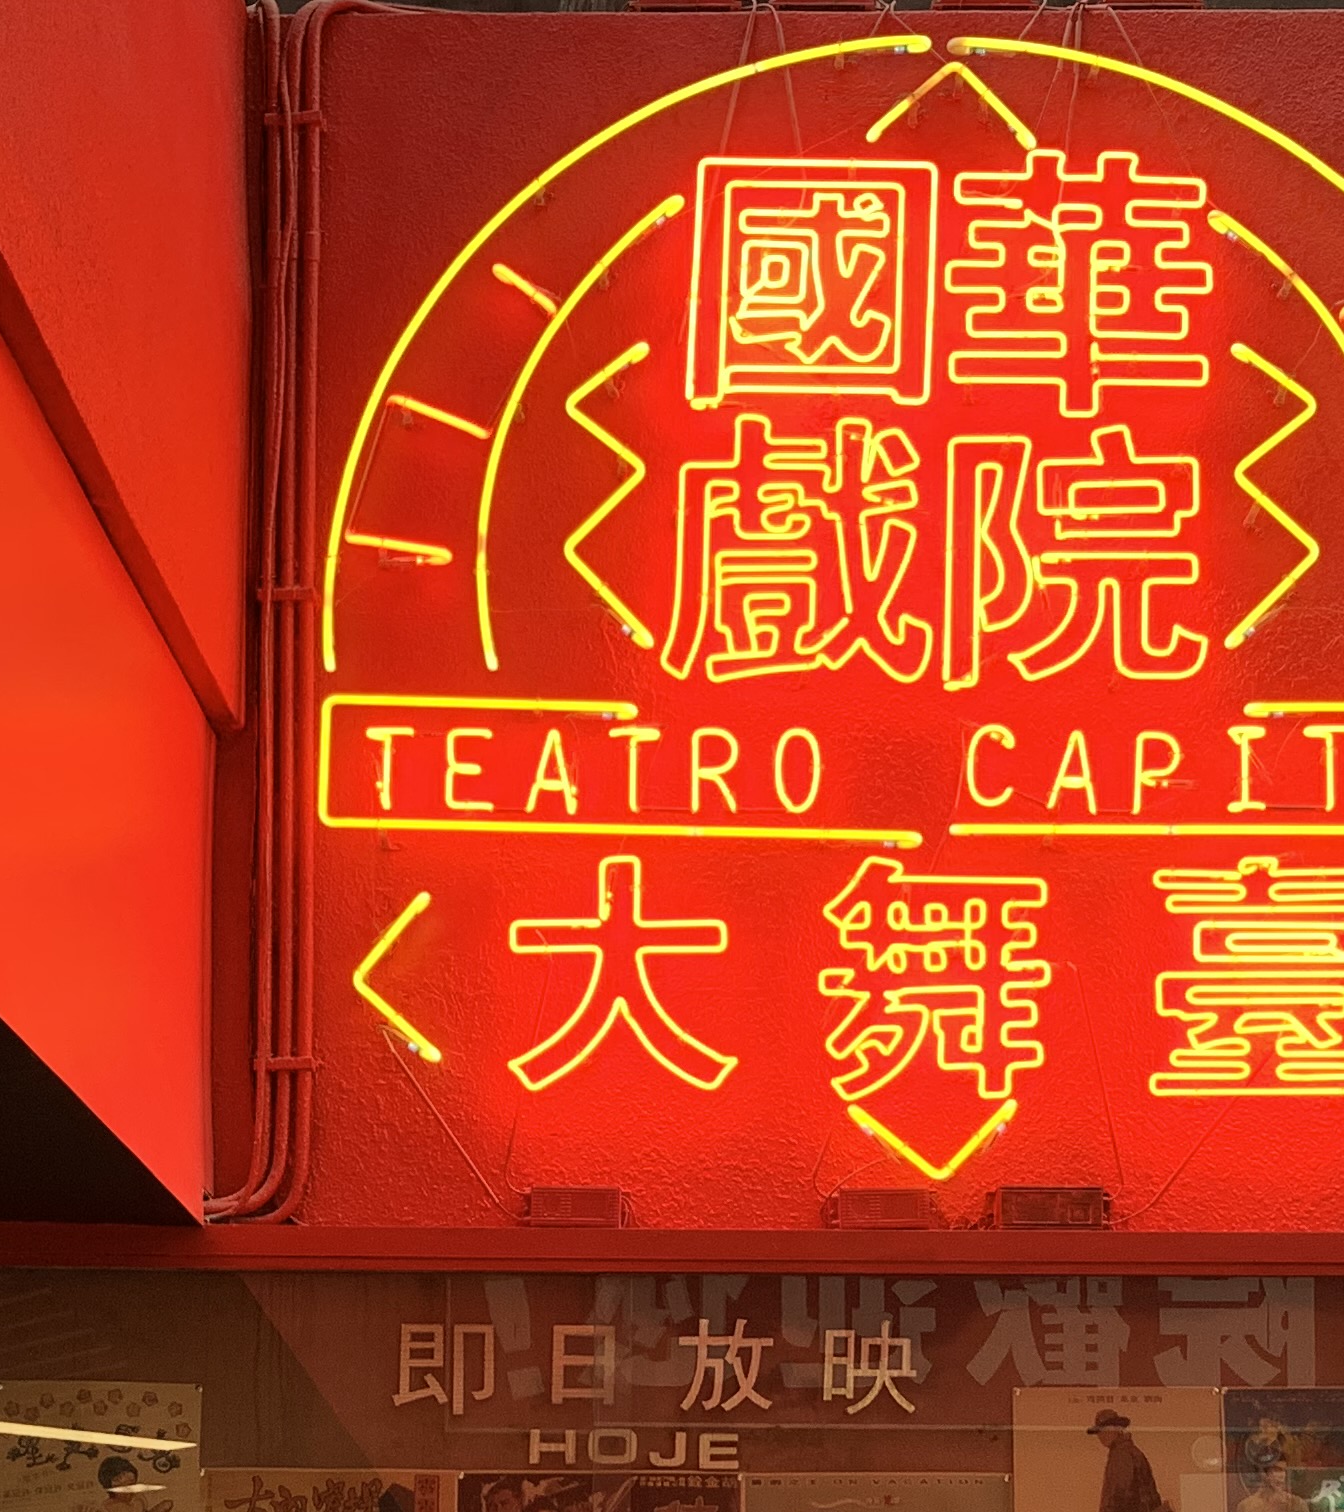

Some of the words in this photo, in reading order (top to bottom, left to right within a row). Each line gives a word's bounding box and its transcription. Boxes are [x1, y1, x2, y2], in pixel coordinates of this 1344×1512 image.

[661, 413, 1208, 691] 戲院
[369, 724, 823, 816] TEATRO
[392, 1318, 917, 1415] 即日放映
[529, 1428, 740, 1469] HOJE
